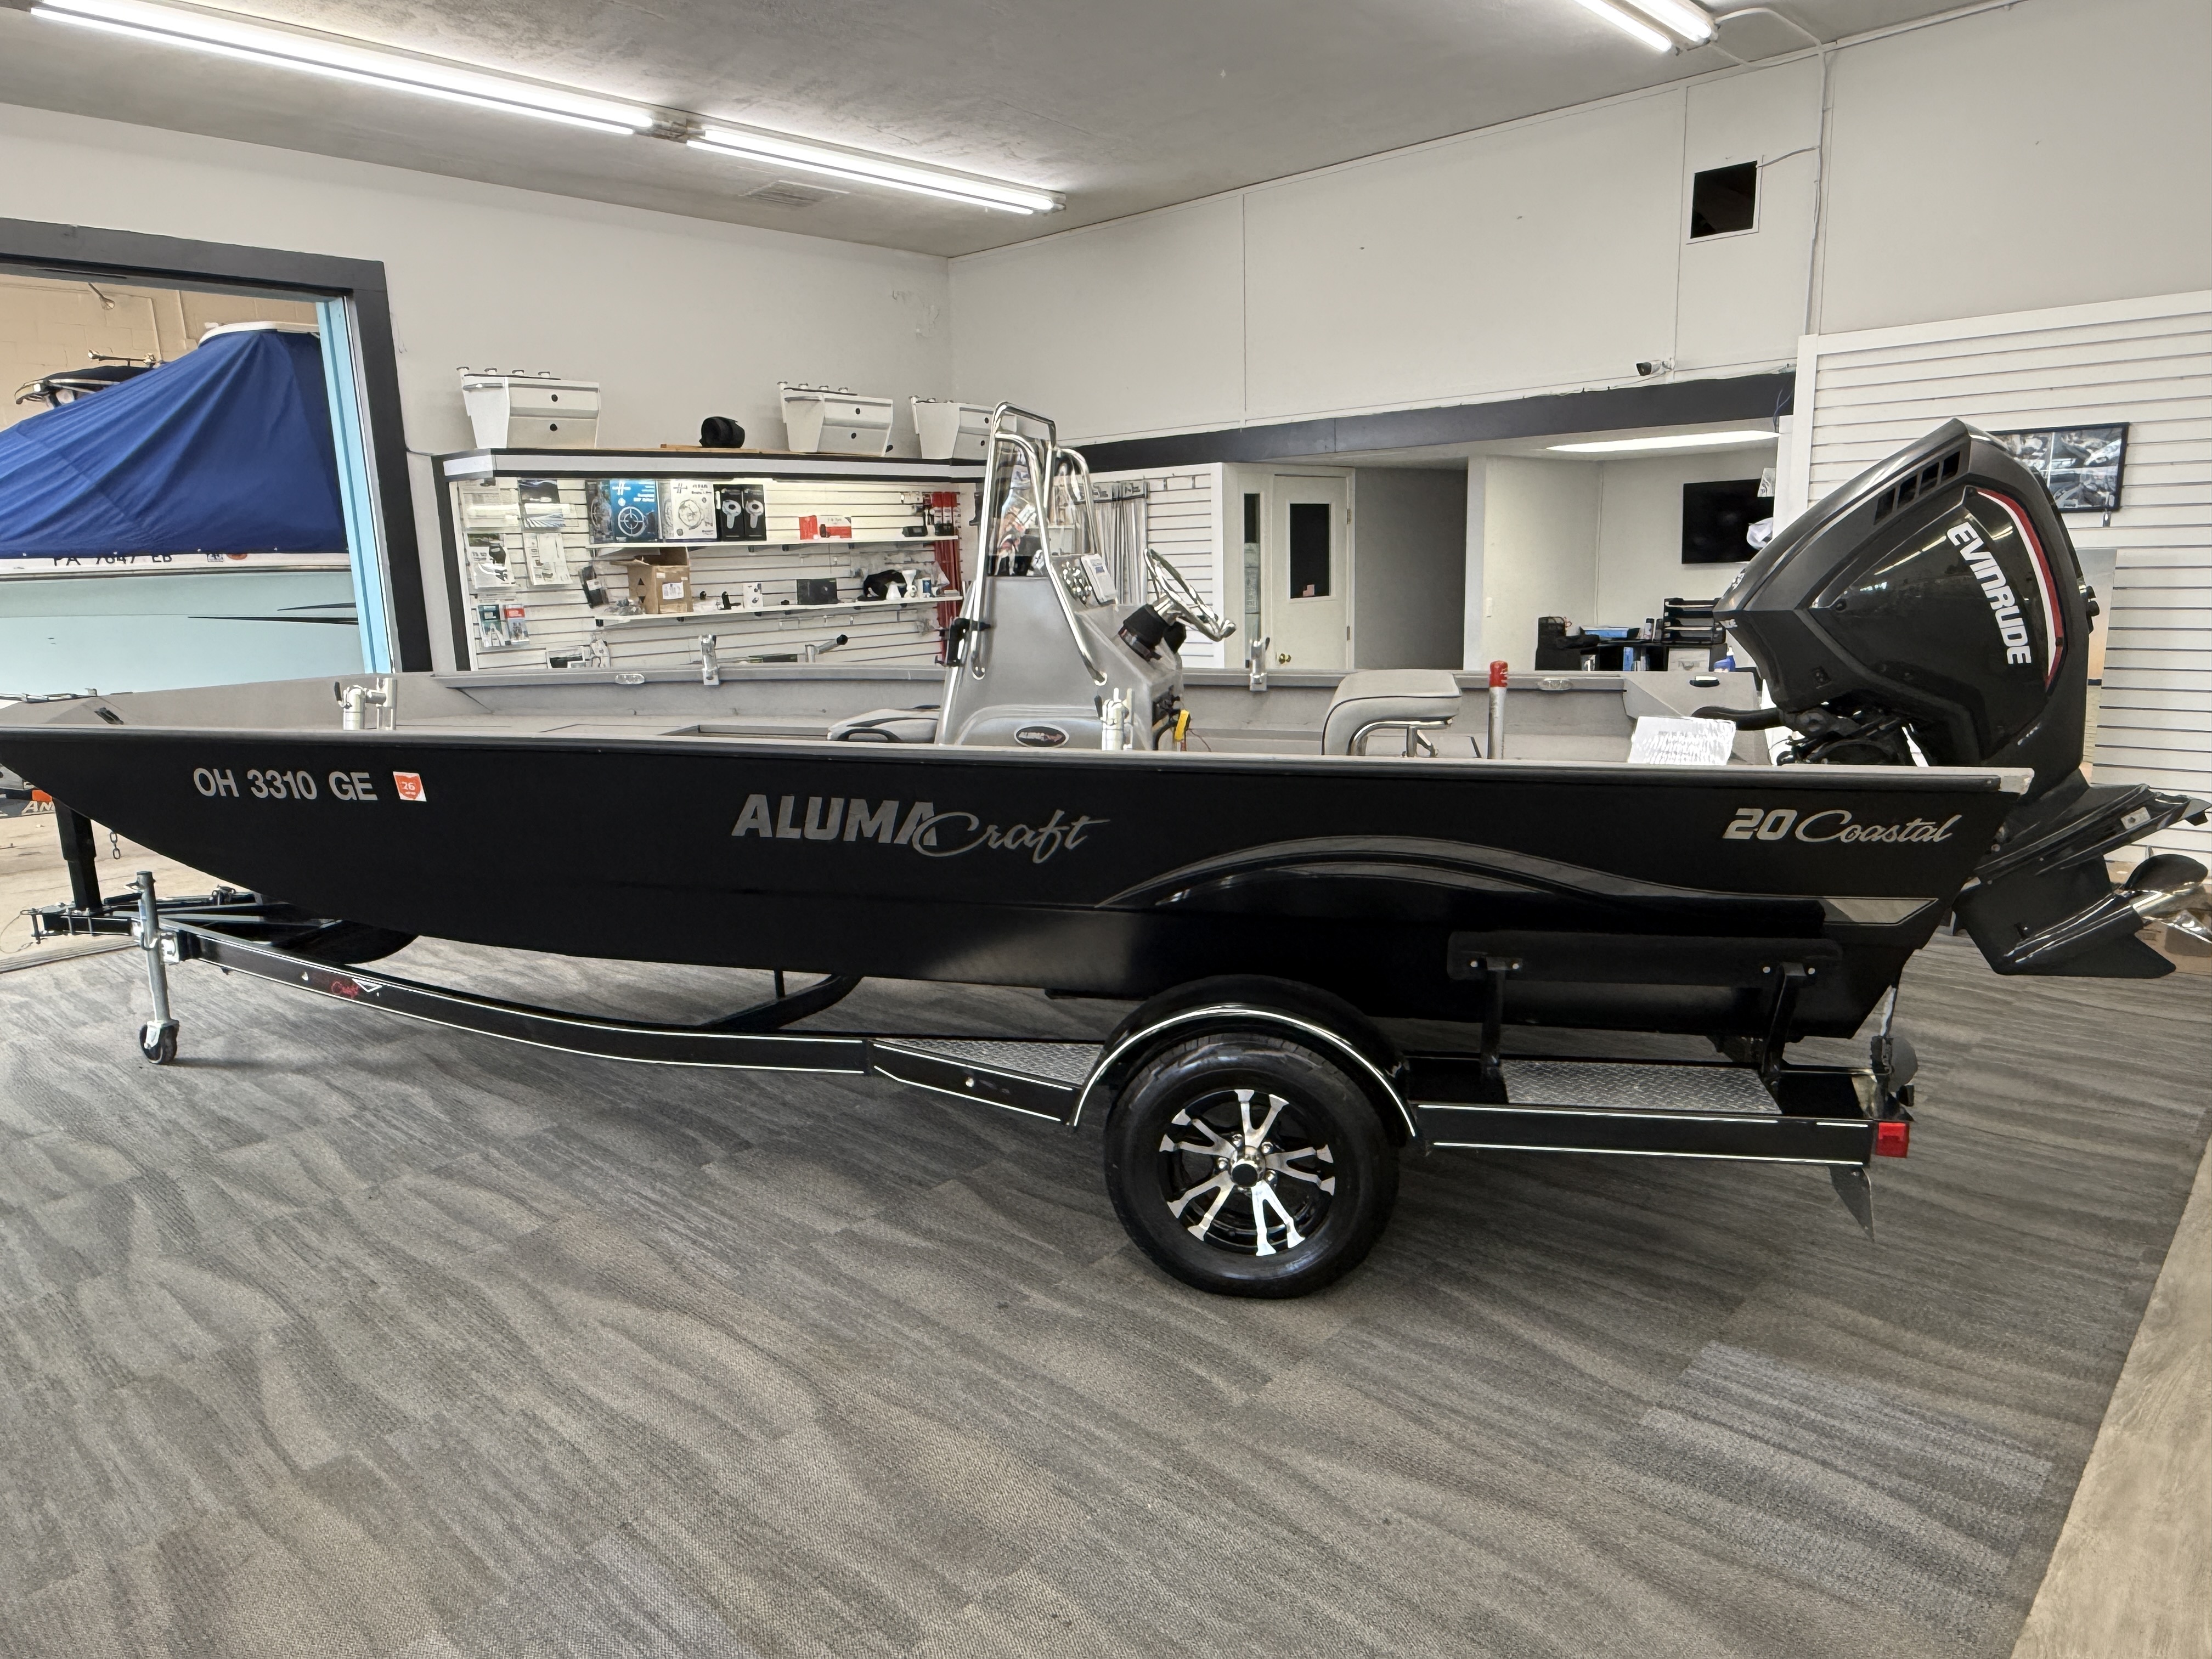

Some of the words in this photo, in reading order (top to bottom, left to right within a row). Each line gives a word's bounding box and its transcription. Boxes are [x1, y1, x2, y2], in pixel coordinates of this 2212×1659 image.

[1946, 521, 2032, 664] EVINRUDE
[194, 768, 240, 797] OH
[247, 769, 317, 800] 3310
[329, 771, 378, 800] GE
[1723, 808, 1798, 840] 20
[1795, 809, 1962, 843] Coastal
